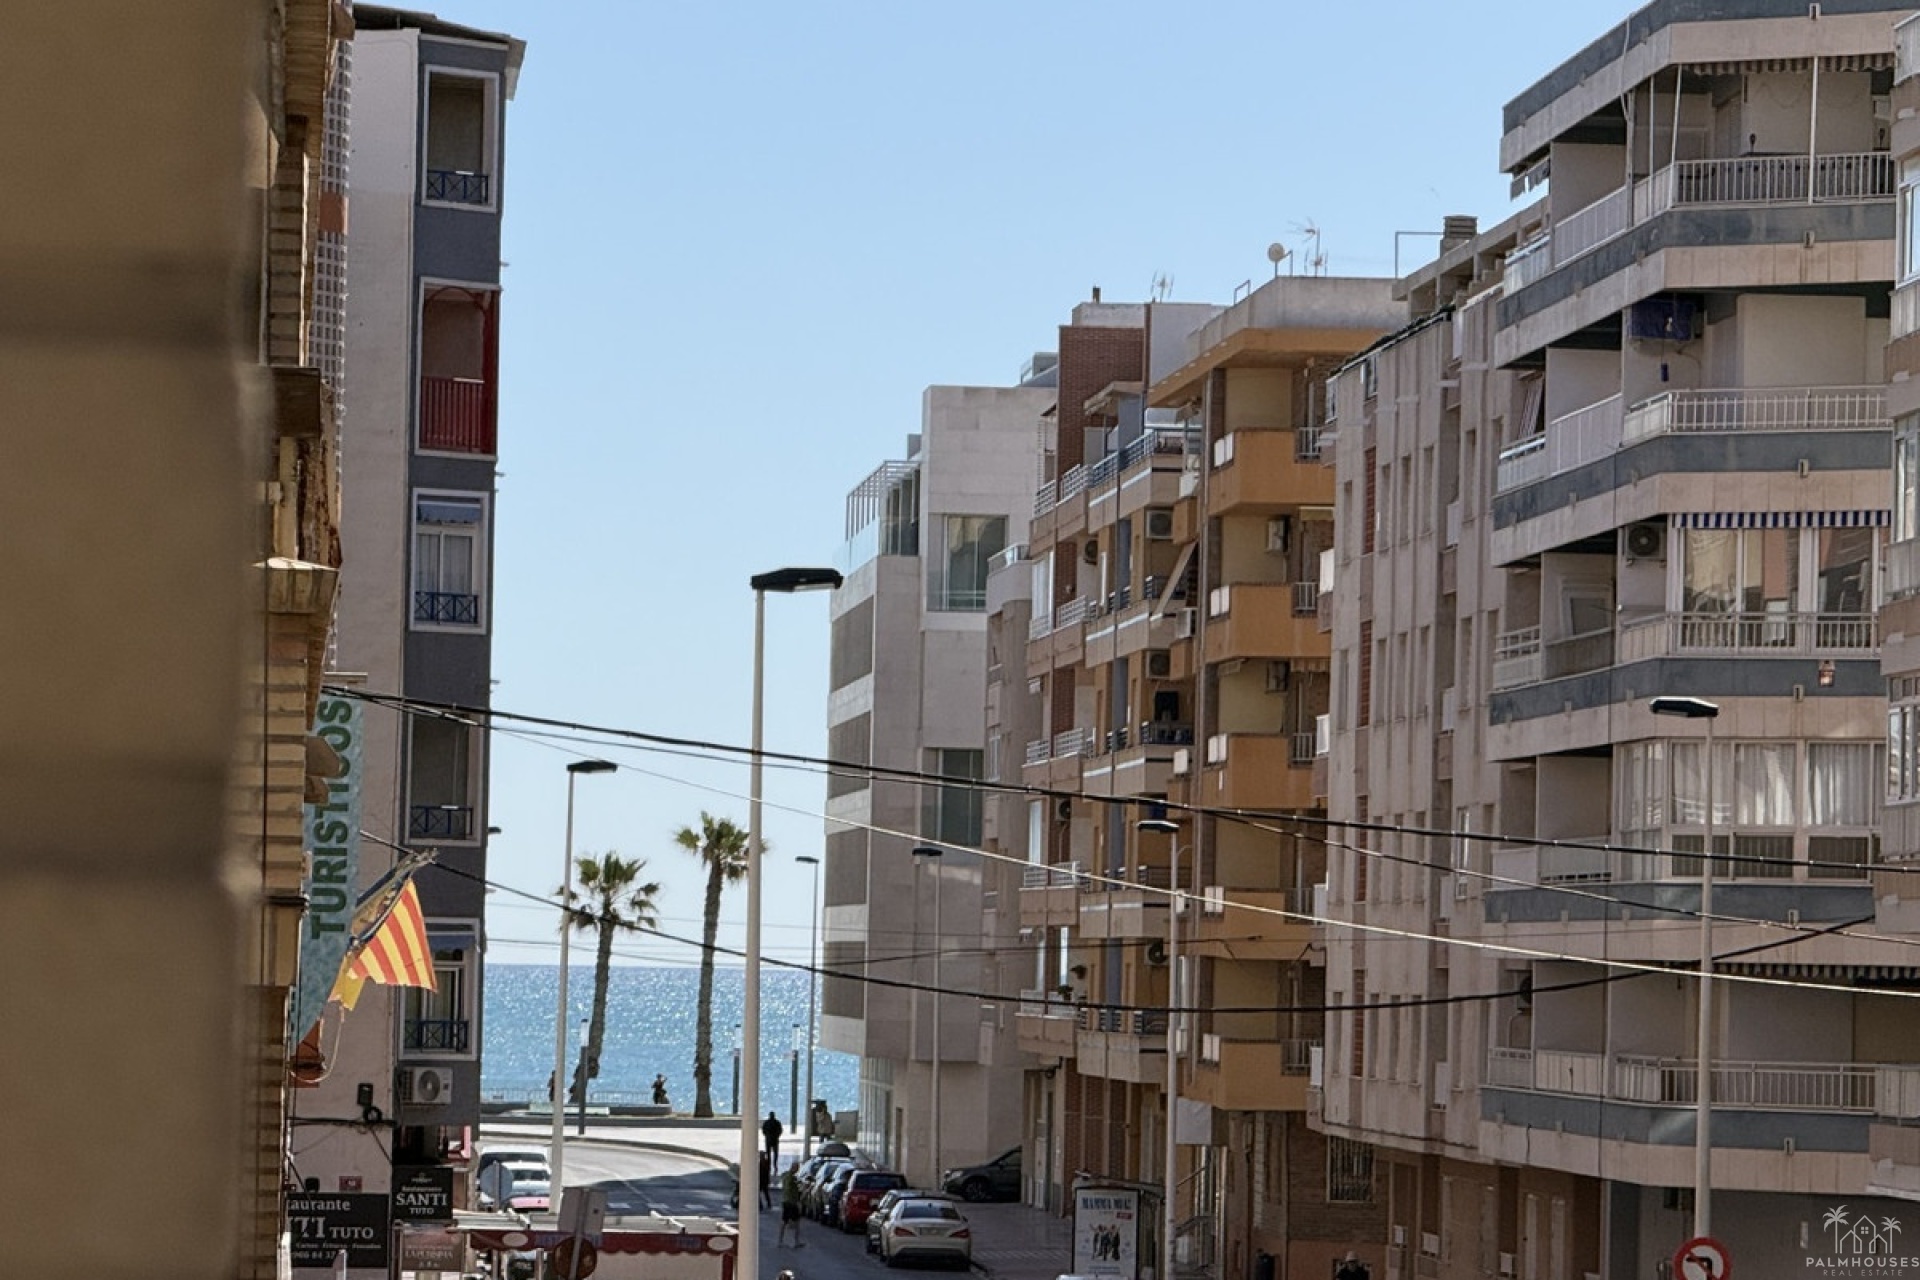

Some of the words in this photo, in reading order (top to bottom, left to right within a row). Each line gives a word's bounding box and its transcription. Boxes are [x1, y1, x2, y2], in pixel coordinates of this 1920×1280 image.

[311, 699, 352, 940] TURISTIOS
[396, 1192, 448, 1206] SANTI
[409, 1207, 435, 1215] TUTO
[329, 1227, 374, 1239] TUTO
